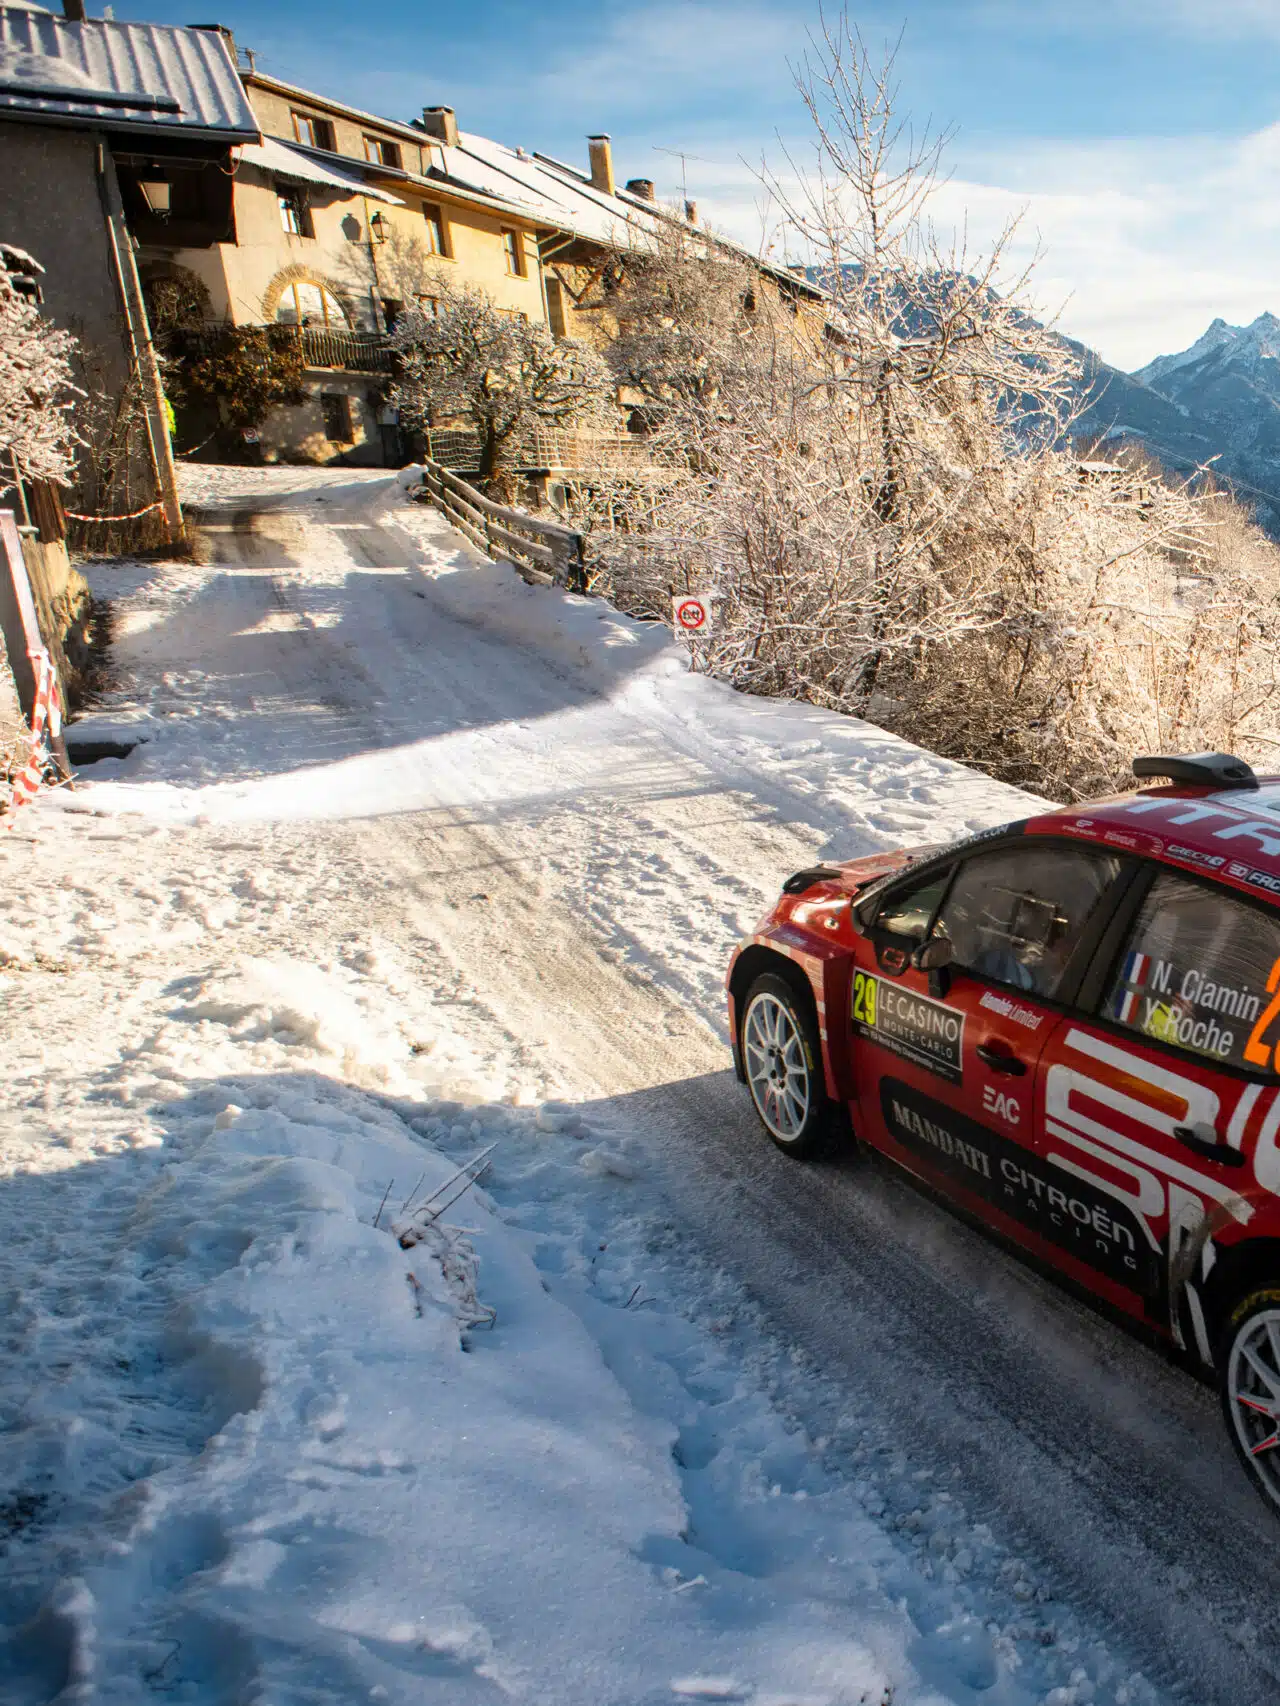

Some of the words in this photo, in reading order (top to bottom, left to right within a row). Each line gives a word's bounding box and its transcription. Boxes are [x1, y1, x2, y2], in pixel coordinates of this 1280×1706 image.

[854, 974, 877, 1025] 29
[879, 988, 894, 1014] LE
[896, 997, 959, 1042] CASINO
[1007, 1004, 1044, 1030] Limited
[1151, 960, 1172, 994] N.
[1181, 969, 1260, 1022] Ciamin
[1143, 997, 1161, 1031] Y.
[1164, 1006, 1234, 1057] Roche
[983, 1085, 1020, 1124] EAC
[892, 1100, 992, 1179] MANDATI
